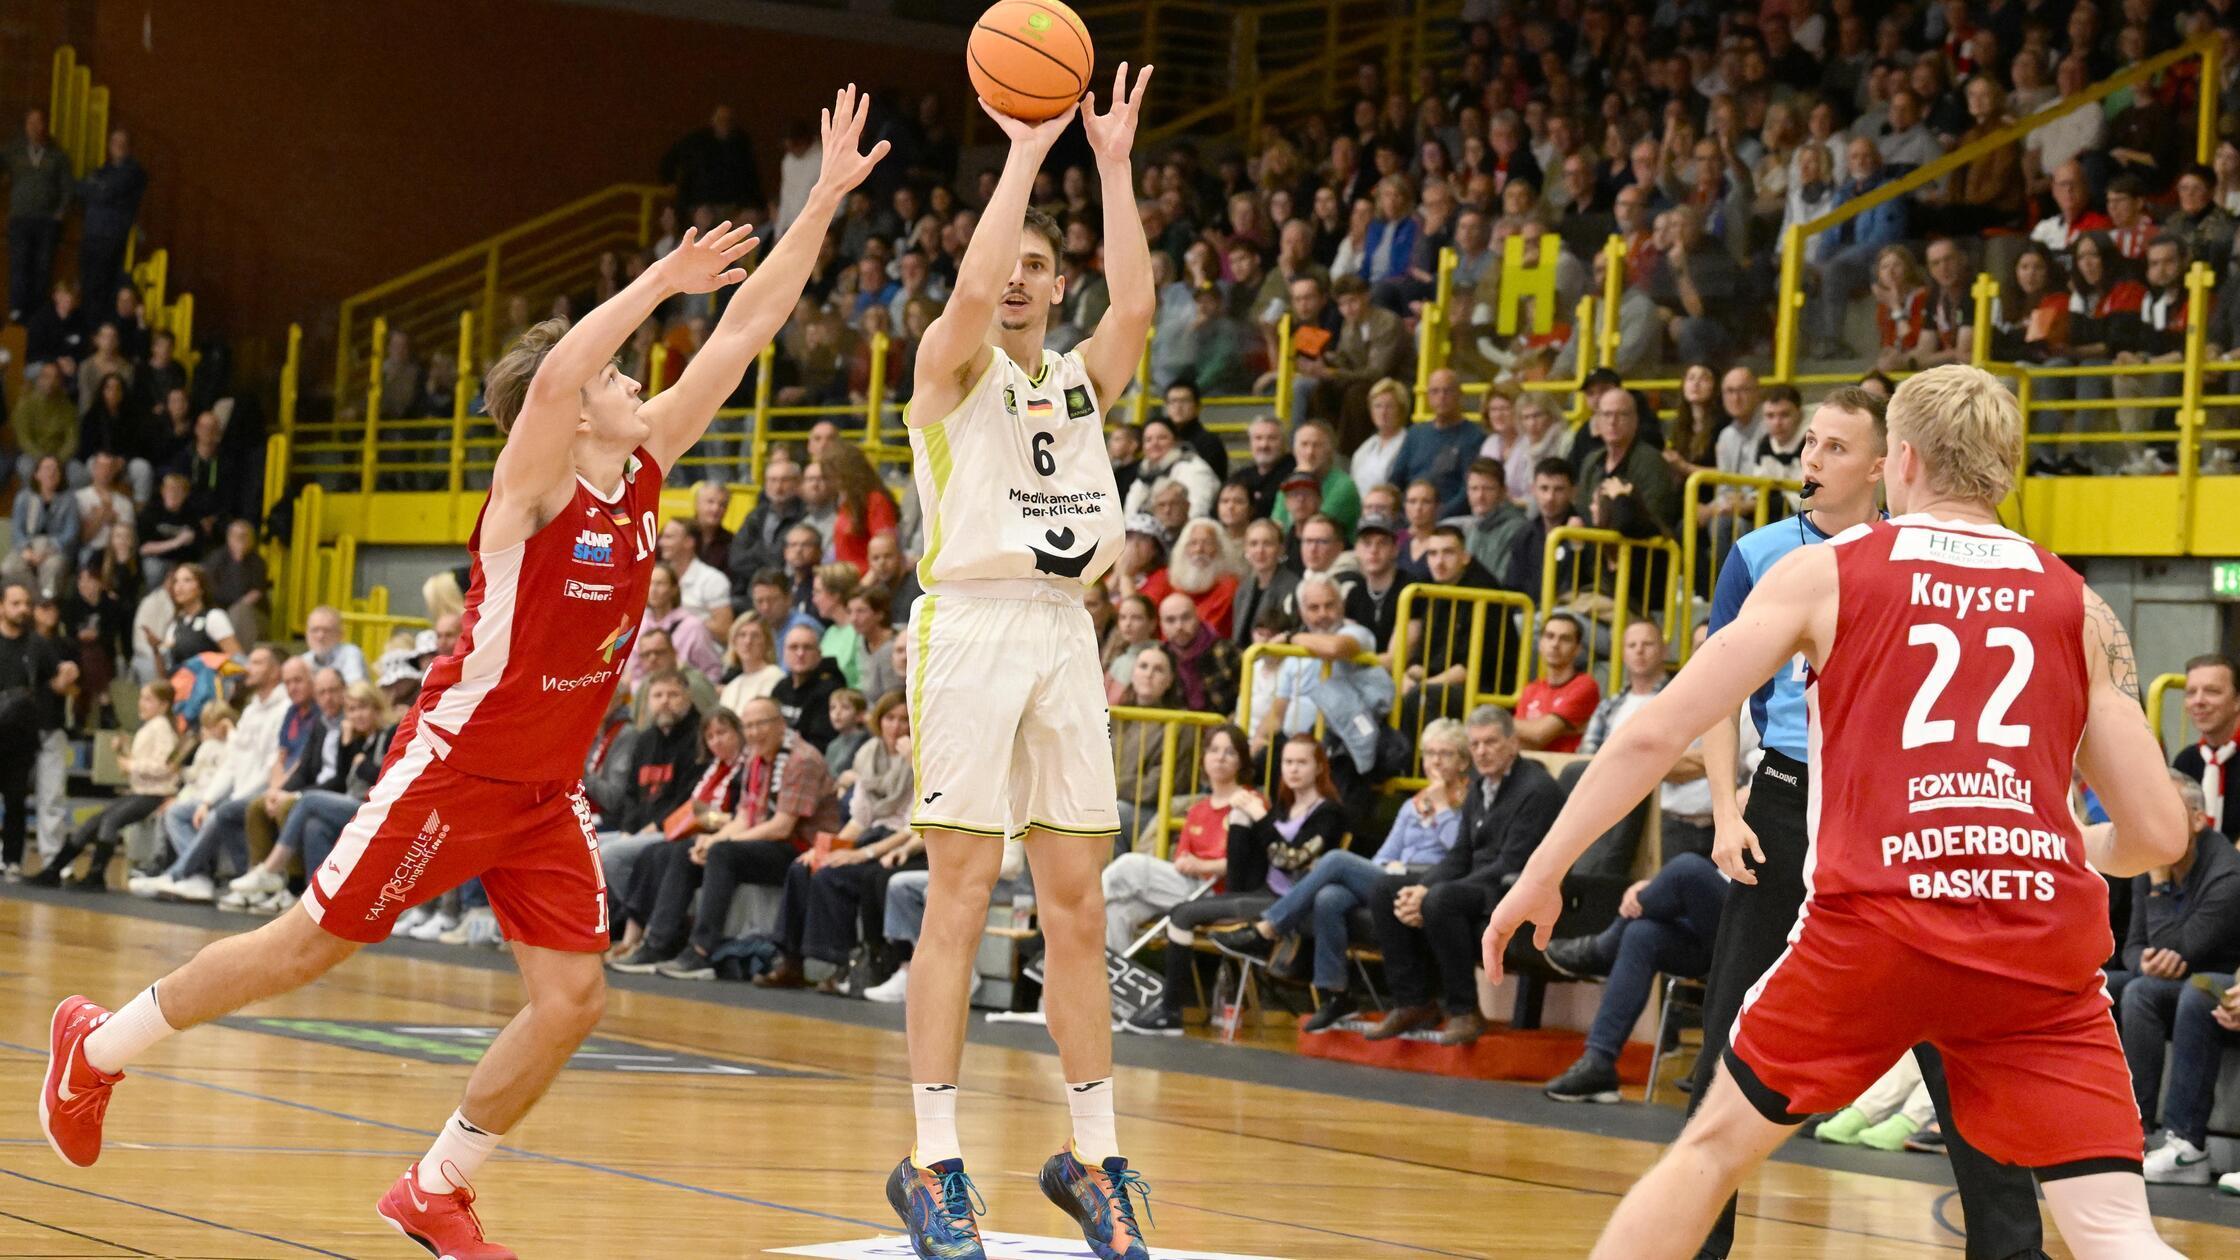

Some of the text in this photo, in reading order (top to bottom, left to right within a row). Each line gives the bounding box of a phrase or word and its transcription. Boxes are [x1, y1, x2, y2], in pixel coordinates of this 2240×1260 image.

[1032, 431, 1056, 477] 6
[1009, 488, 1106, 504] Medikamente-
[1023, 504, 1101, 518] per-Klick.de
[575, 530, 614, 548] JUMP
[636, 510, 657, 562] 10
[1930, 534, 2002, 557] HESSE
[572, 543, 613, 563] SHOT
[1910, 572, 2035, 620] Kayser
[1902, 623, 2035, 750] 22
[1764, 765, 1798, 787] SPALDING
[1908, 758, 2032, 804] FOXWATCH
[1881, 825, 2070, 868] PADERBORN
[1908, 869, 2055, 901] BASKETS
